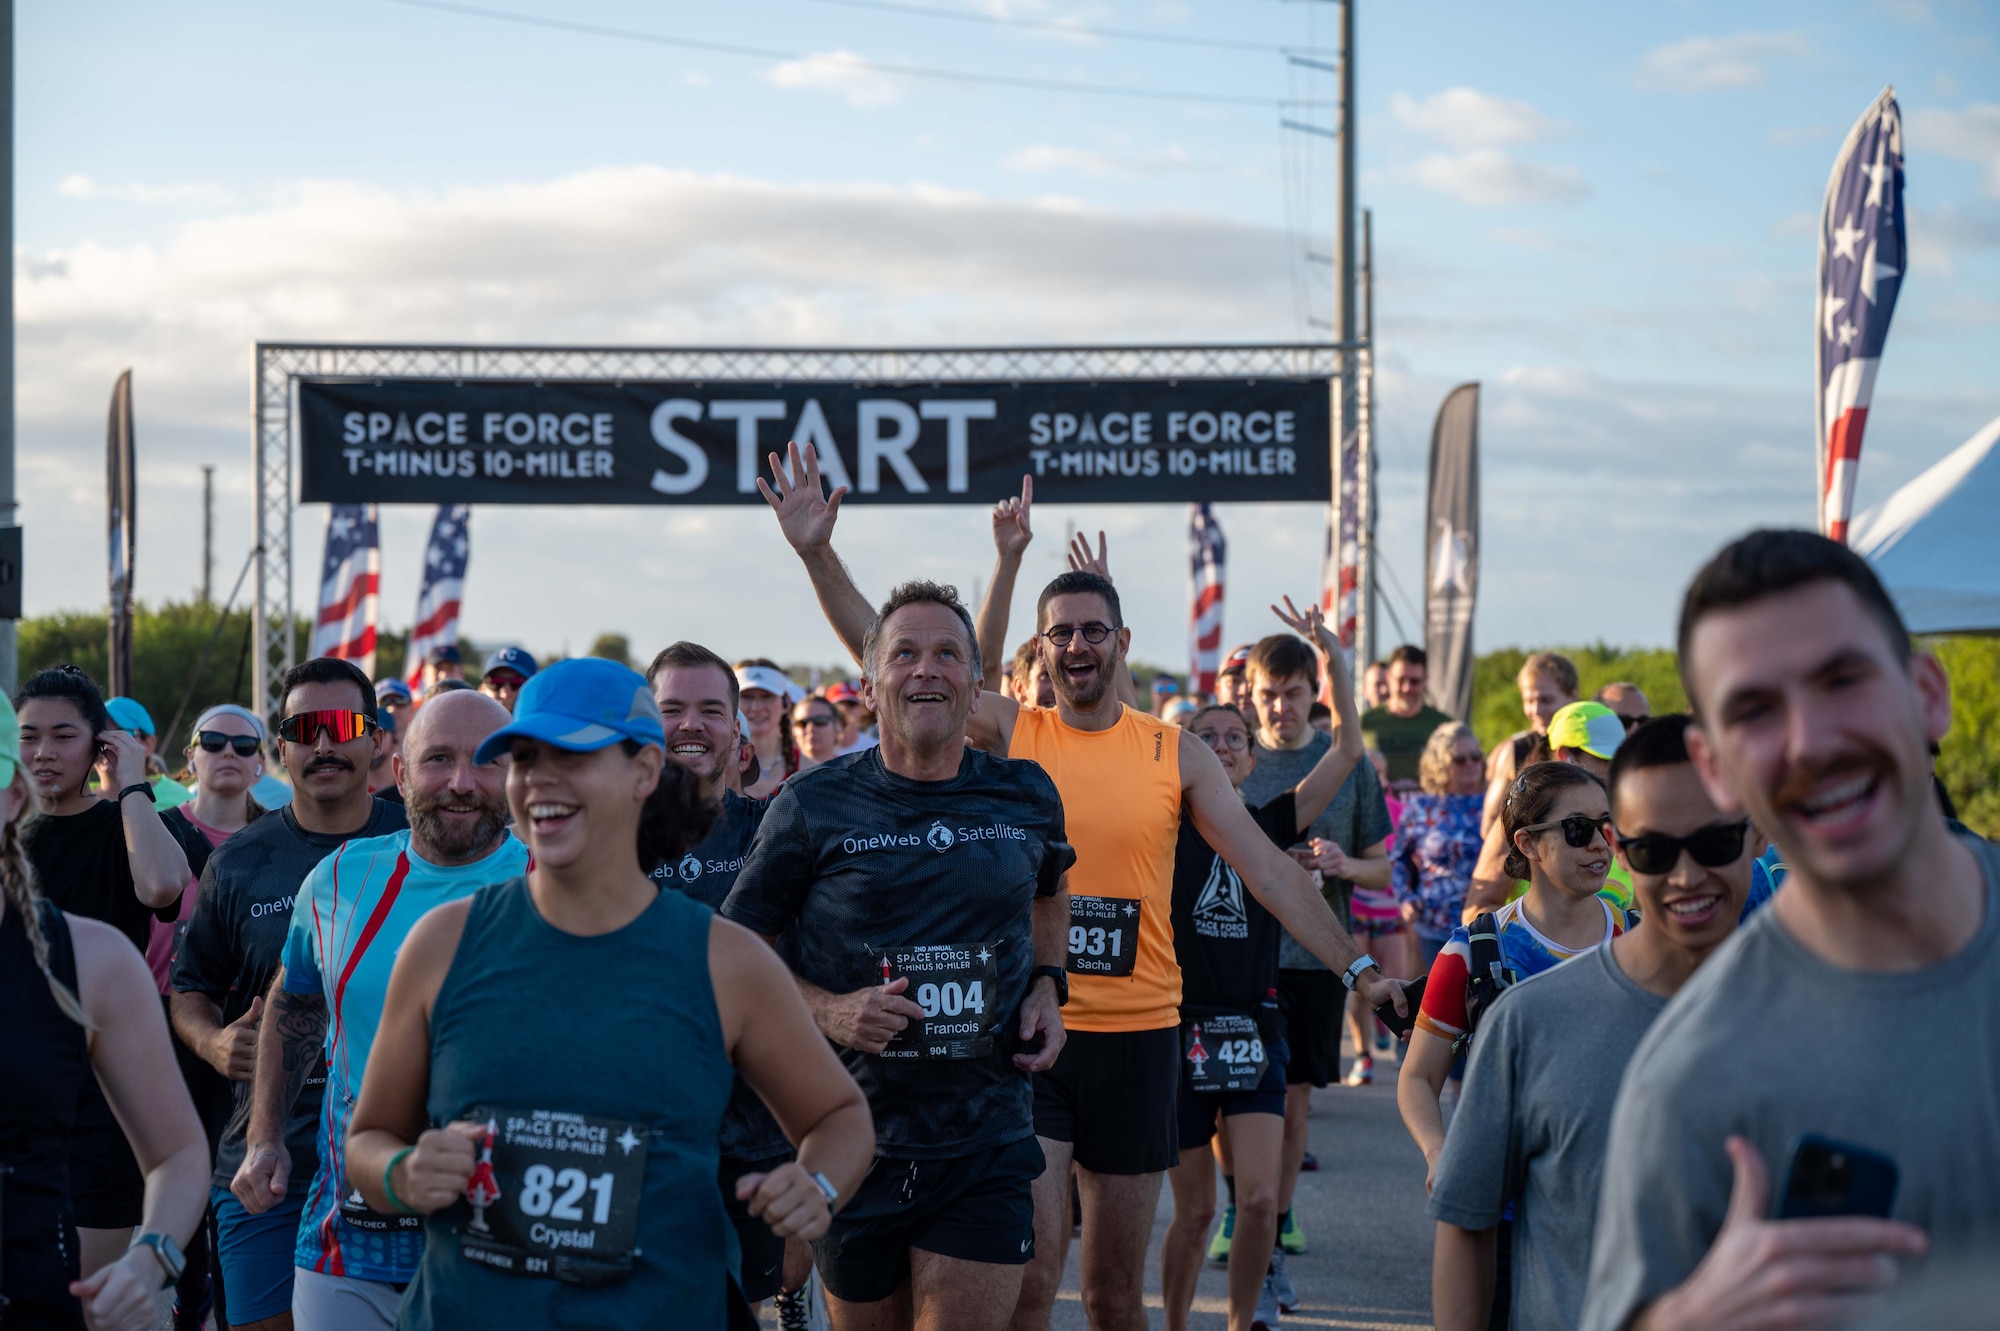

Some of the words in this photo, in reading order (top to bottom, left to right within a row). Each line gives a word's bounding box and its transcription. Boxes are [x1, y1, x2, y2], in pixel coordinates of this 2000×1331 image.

[343, 412, 467, 445] SPACE
[484, 412, 613, 445] FORCE
[1029, 411, 1152, 445] SPACE
[1169, 411, 1296, 444] FORCE
[650, 398, 996, 495] START
[343, 449, 476, 478] T-MINUS
[484, 449, 614, 478] 10-MILER
[1029, 448, 1160, 477] T-MINUS
[1169, 447, 1296, 476] 10-MILER
[843, 834, 921, 854] OneWeb
[957, 823, 1027, 842] Satellites
[706, 855, 747, 874] Satell
[250, 894, 298, 918] OneW
[1086, 901, 1117, 911] FORCE
[1193, 918, 1218, 931] PACE
[1220, 922, 1248, 932] FORCE
[1196, 928, 1219, 938] MINUS
[914, 945, 927, 953] 2ND
[1068, 925, 1122, 957] 931
[897, 953, 930, 963] SPACE
[934, 951, 970, 961] FORCE
[897, 963, 933, 972] T-MINUS
[935, 961, 971, 971] 10-MILER
[1077, 958, 1111, 970] Sacha
[917, 980, 985, 1018] 904
[925, 1020, 980, 1035] Francois
[880, 1050, 896, 1058] GEAR
[897, 1050, 919, 1058] CHECK
[929, 1046, 947, 1055] 904
[1218, 1038, 1264, 1064] 428
[505, 1116, 553, 1135] SPACE
[557, 1123, 608, 1143] FORCE
[504, 1132, 554, 1150] T-MINUS
[555, 1139, 607, 1156] 10-MILER
[518, 1163, 615, 1225] 821
[363, 1220, 387, 1229] CHECK
[399, 1217, 418, 1227] 963
[529, 1222, 596, 1250] Crystal
[525, 1257, 549, 1273] 821
